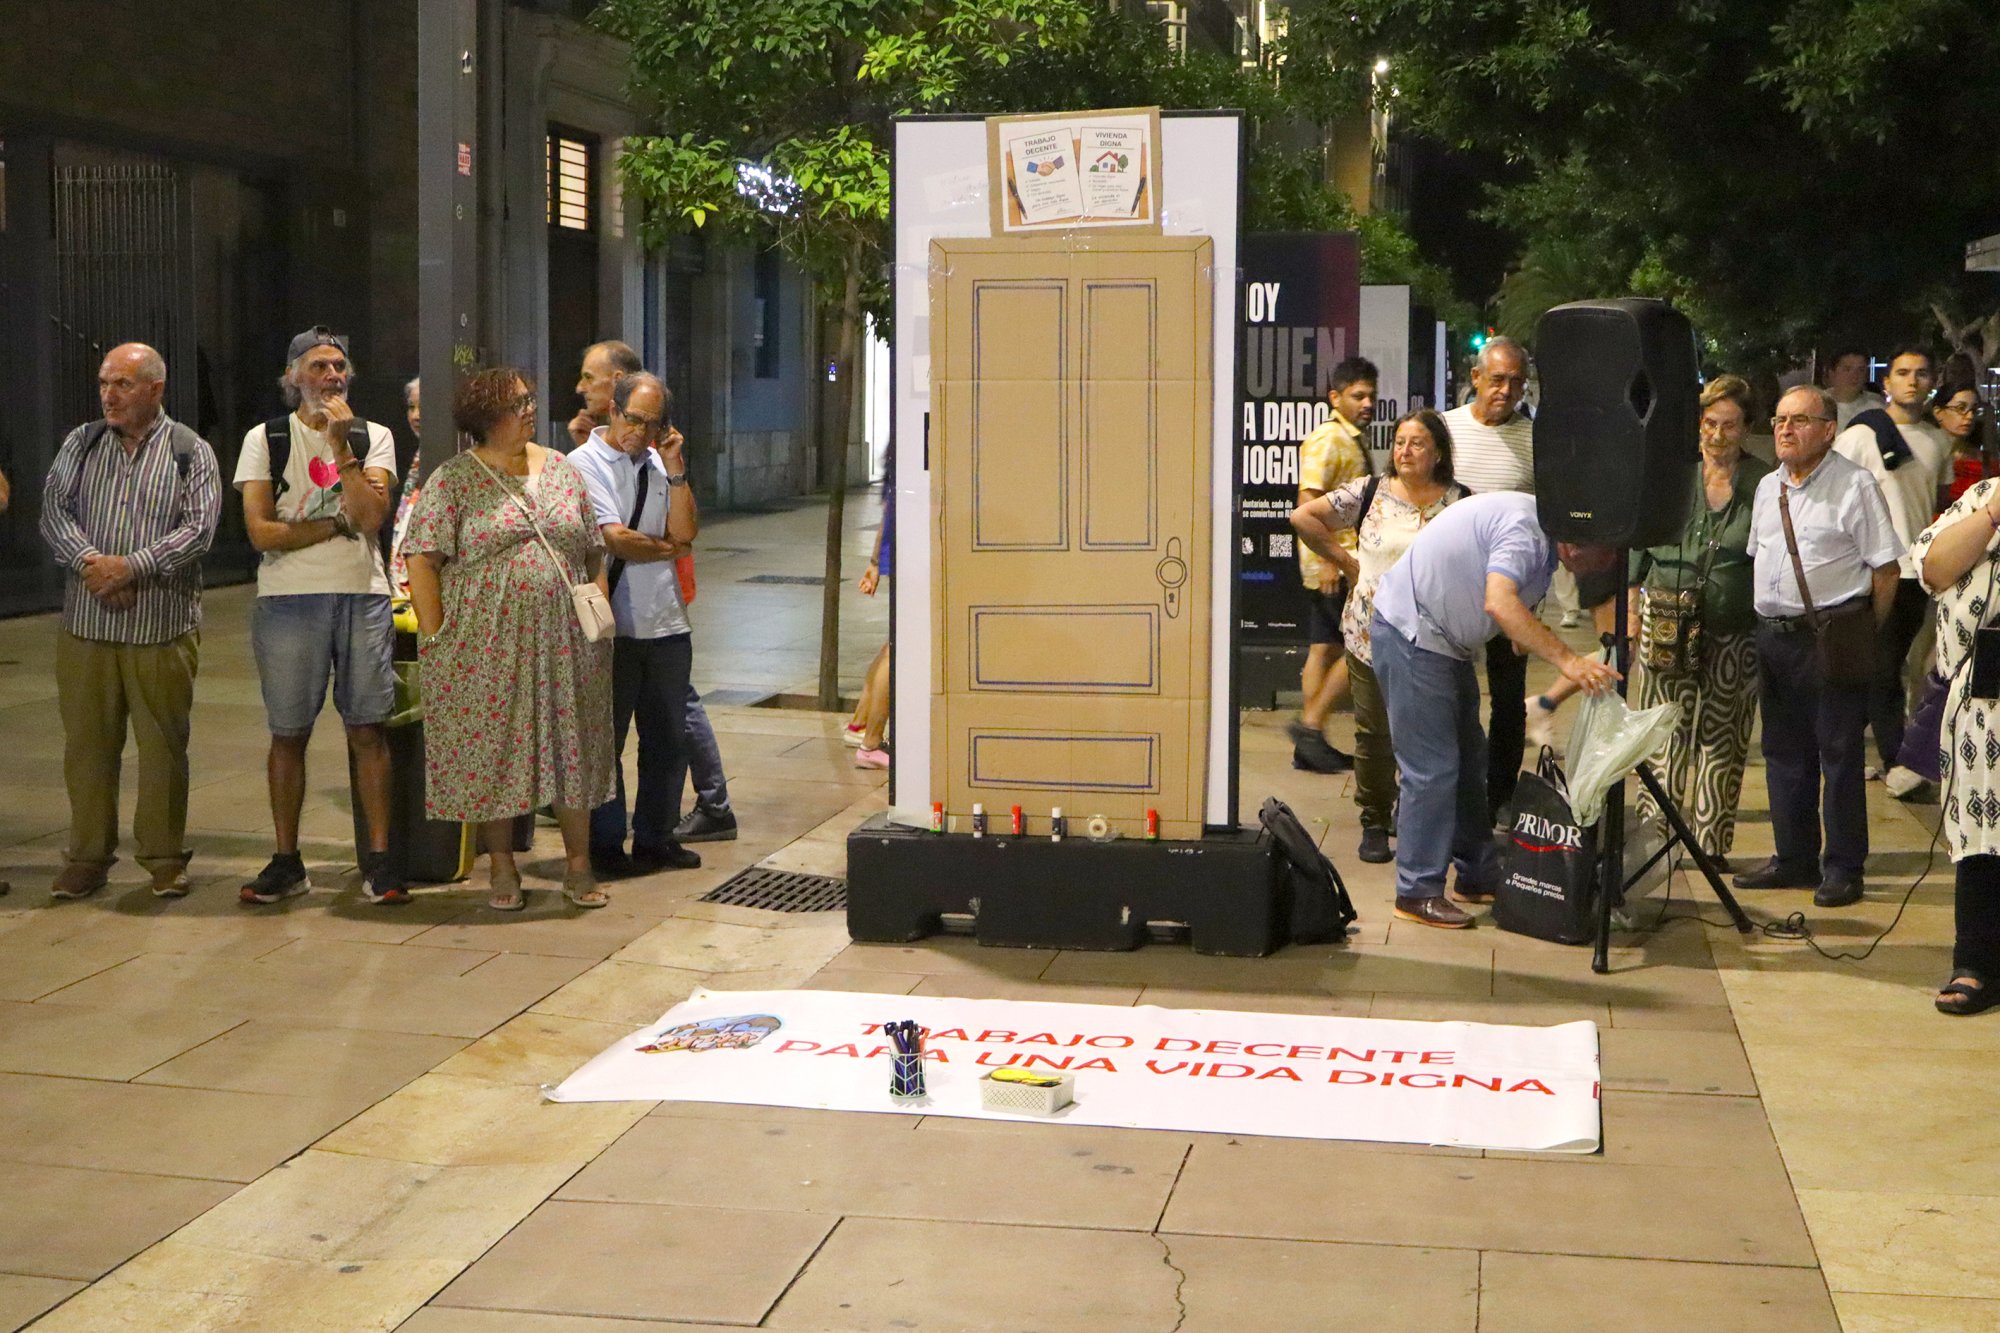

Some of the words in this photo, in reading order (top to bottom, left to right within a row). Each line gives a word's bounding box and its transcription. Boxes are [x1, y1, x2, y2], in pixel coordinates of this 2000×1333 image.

[1024, 135, 1056, 147] TRABAJO
[1095, 132, 1128, 140] VIVIENDA
[1100, 140, 1122, 148] DIGNA
[1025, 143, 1058, 156] DECENTE
[1245, 282, 1280, 322] OY
[1569, 511, 1592, 519] VONYX
[1511, 879, 1543, 895] Pequeños
[1542, 889, 1565, 901] precios
[1512, 872, 1538, 886] Grandes
[1539, 881, 1562, 893] marcas
[1153, 1037, 1456, 1065] DECENTE
[975, 1051, 1119, 1073] UNA
[1145, 1059, 1304, 1082] VIDA
[1327, 1069, 1557, 1096] DIGNA
